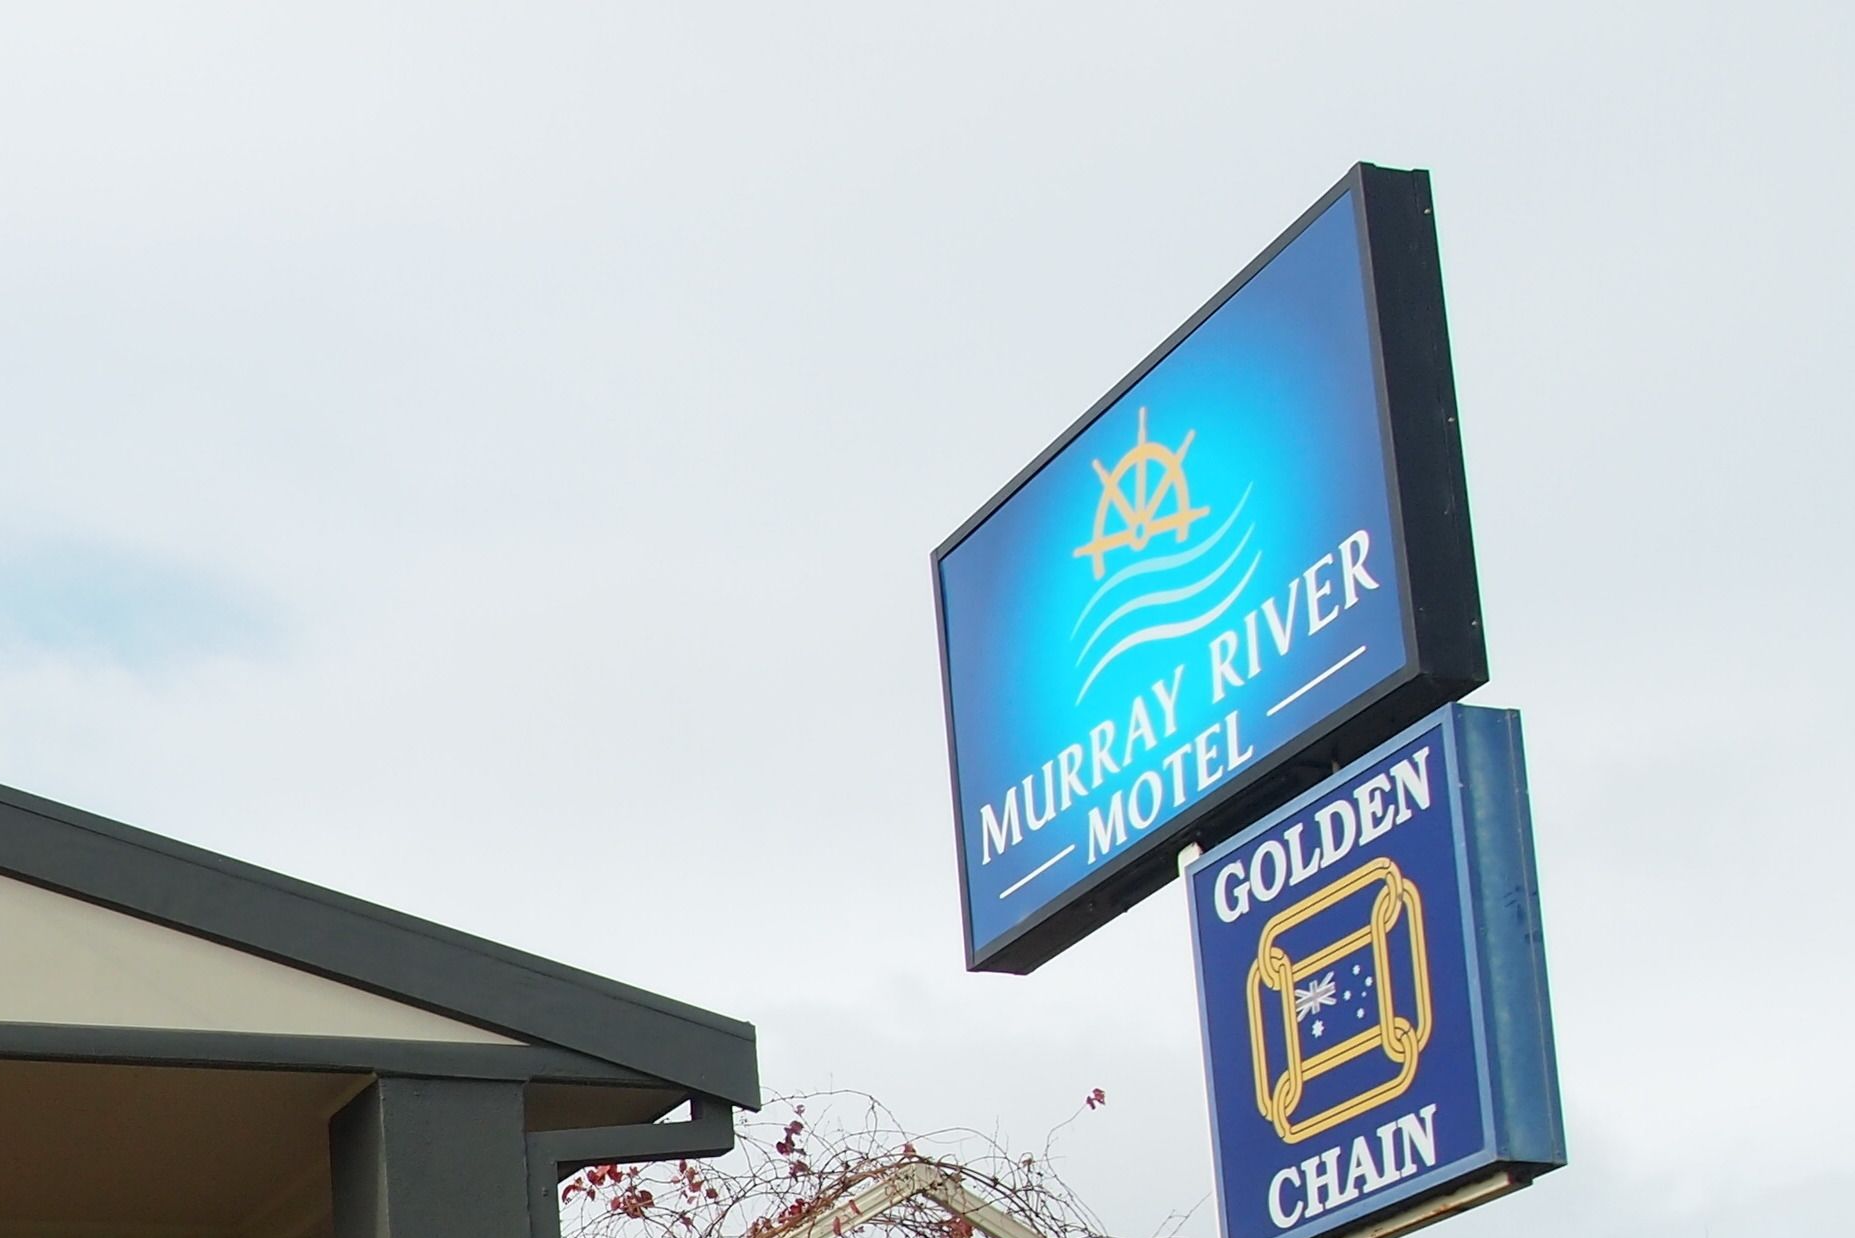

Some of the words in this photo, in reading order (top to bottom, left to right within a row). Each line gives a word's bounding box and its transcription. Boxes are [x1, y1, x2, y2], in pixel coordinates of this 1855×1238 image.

[979, 664, 1184, 866] MURRAY
[1208, 528, 1380, 705] RIVER
[1087, 709, 1255, 865] MOTEL
[1214, 746, 1431, 924] GOLDEN
[1267, 1104, 1438, 1229] CHAIN
